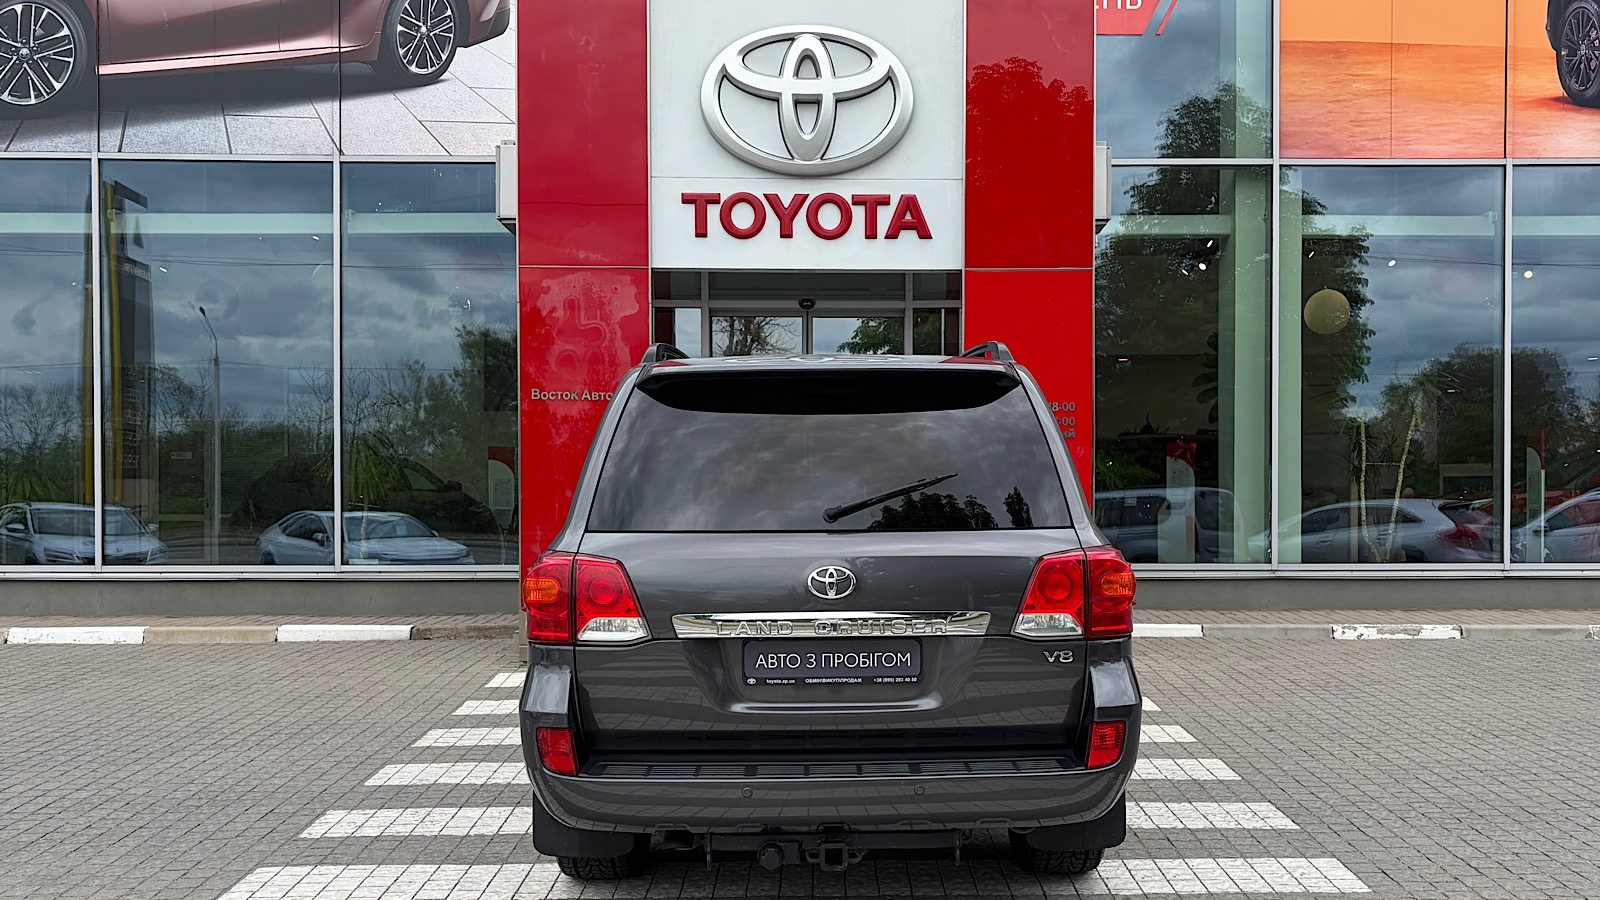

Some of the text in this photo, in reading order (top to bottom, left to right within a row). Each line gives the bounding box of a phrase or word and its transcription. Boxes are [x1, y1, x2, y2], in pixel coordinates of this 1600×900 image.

[681, 192, 933, 240] TOYOTA
[531, 388, 614, 401] Восток Авто
[716, 619, 948, 635] LAND CRUISER
[755, 653, 801, 669] АВТО
[821, 652, 911, 668] ПРОБІГОМ
[1043, 650, 1074, 663] V8
